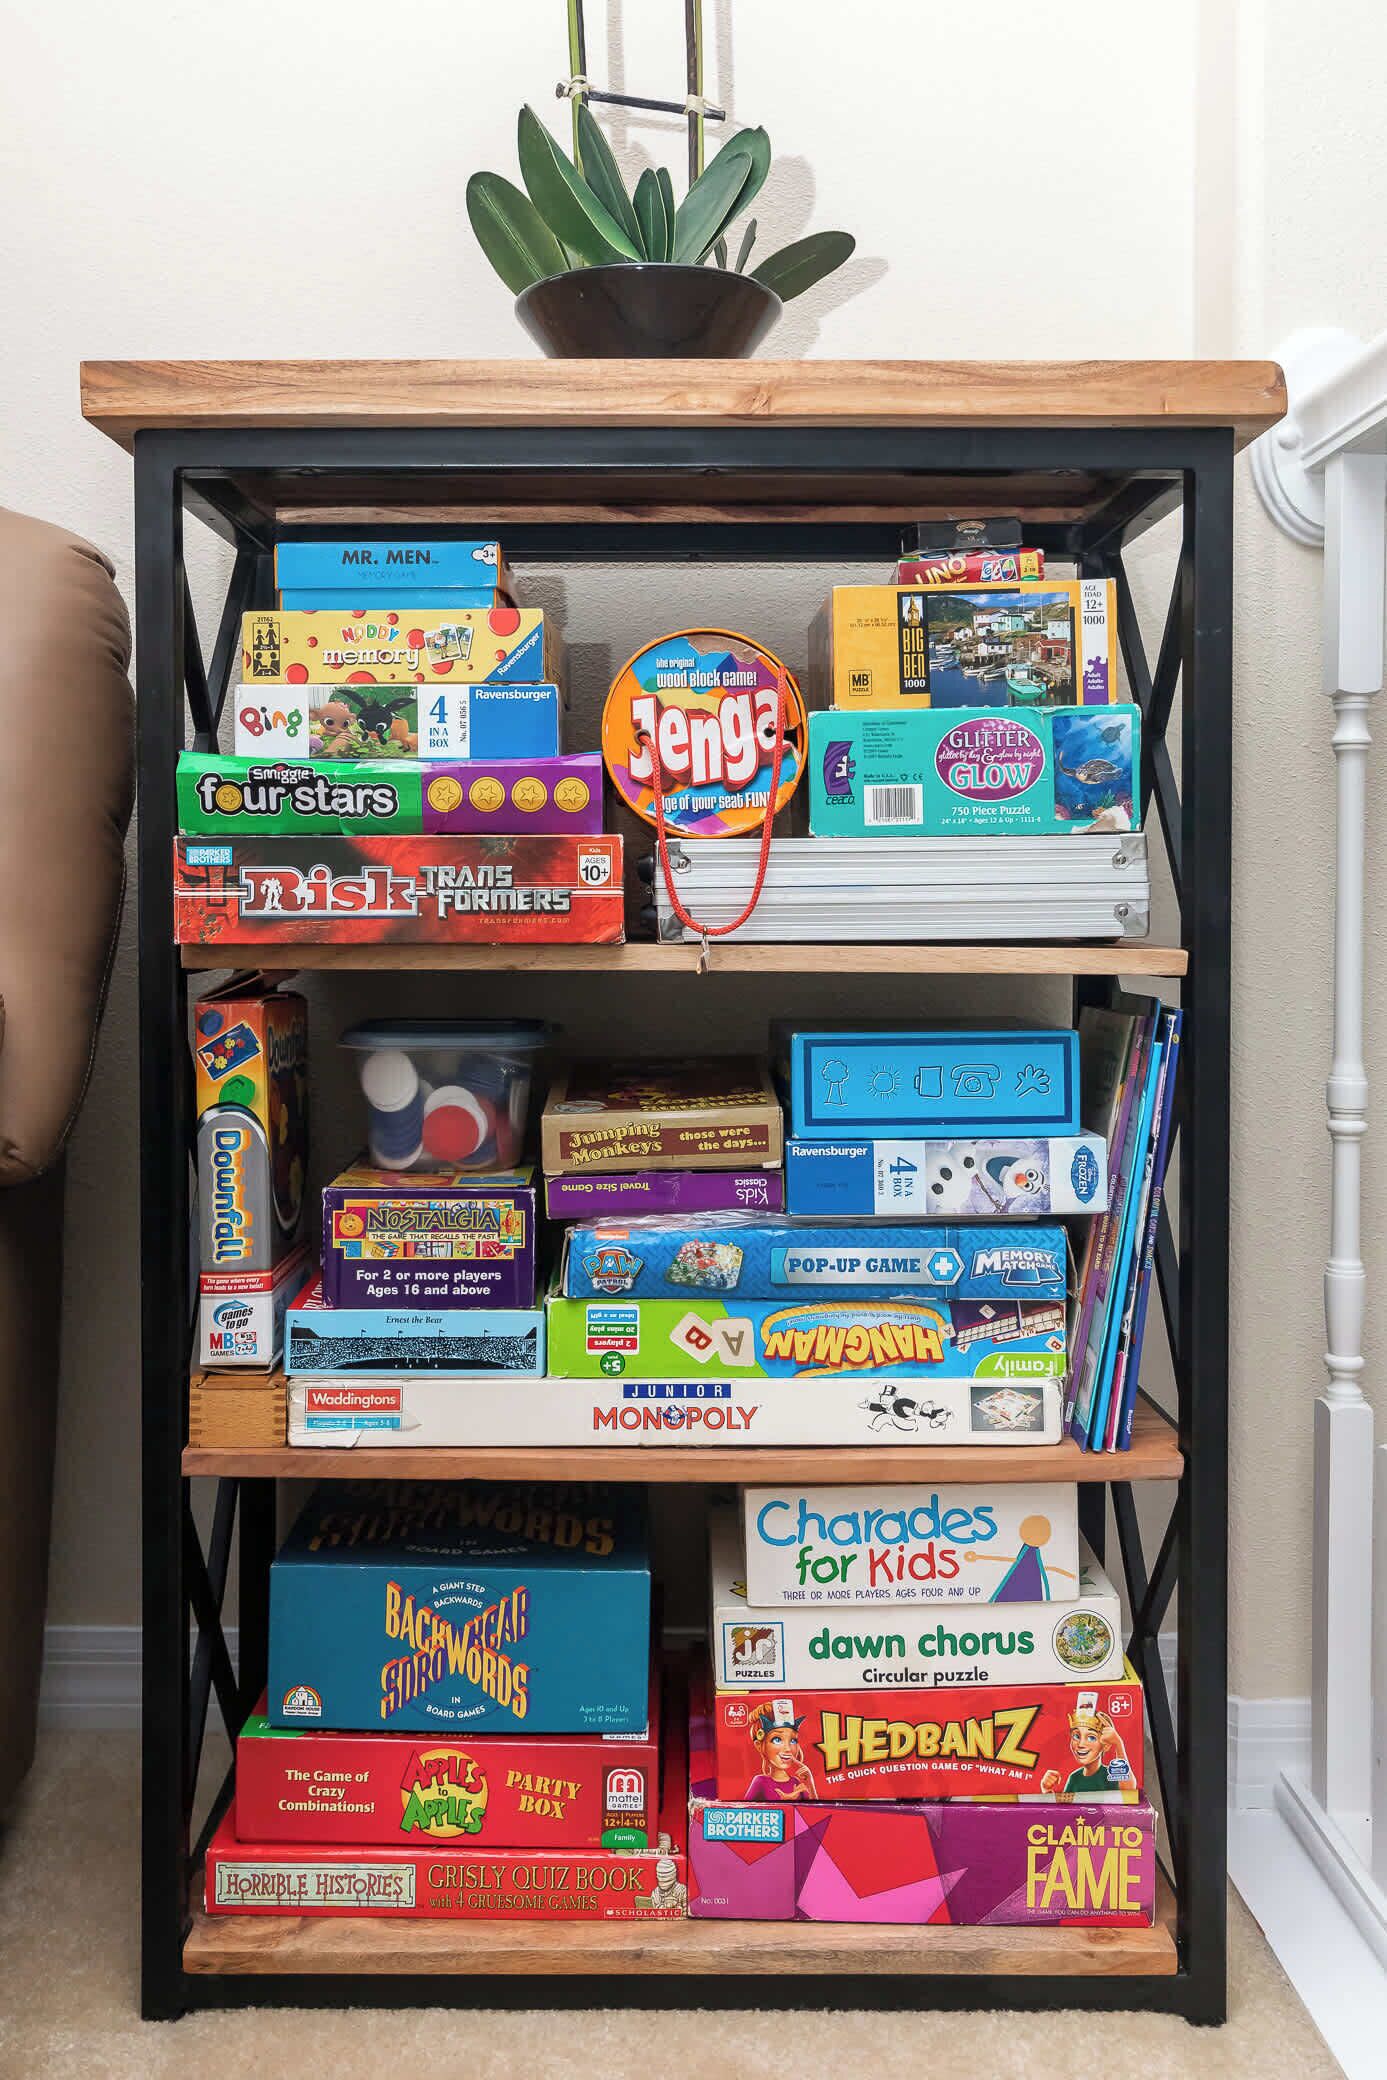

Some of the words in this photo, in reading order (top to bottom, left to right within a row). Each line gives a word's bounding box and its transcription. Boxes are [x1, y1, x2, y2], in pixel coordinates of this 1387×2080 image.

[342, 550, 378, 565] MR.
[386, 550, 430, 565] MEN
[914, 559, 967, 584] UNO
[1086, 600, 1103, 609] 12+
[1083, 615, 1105, 625] 1000
[342, 624, 399, 644] NODDY
[903, 627, 924, 653] BIG
[322, 651, 419, 671] memory
[497, 632, 540, 676] Ravensburger
[656, 658, 669, 668] the
[669, 657, 695, 669] original
[903, 653, 925, 679] BEN
[852, 674, 869, 687] MB
[904, 679, 926, 688] 1000
[475, 689, 552, 702] Ravensburger
[429, 695, 449, 724] 4
[239, 706, 303, 738] Bing
[429, 738, 449, 748] BOX
[628, 685, 780, 790] Jenga
[948, 730, 1031, 748] GLITTER
[948, 763, 1032, 789] GLOW
[199, 776, 286, 812] four
[293, 778, 394, 814] stars
[951, 806, 970, 816] 750
[972, 806, 998, 816] Piece
[999, 805, 1031, 815] Puzzle
[190, 855, 231, 864] BROTHERS
[419, 865, 513, 894] TRANS
[582, 865, 609, 881] 10+
[244, 868, 415, 912] Risk
[437, 889, 572, 919] FORMERS
[569, 1122, 662, 1148] Jumping
[679, 1129, 716, 1142] those
[718, 1127, 751, 1137] were
[698, 1141, 720, 1151] the
[723, 1136, 767, 1149] days...
[570, 1140, 663, 1167] Monkeys
[792, 1146, 868, 1159] Ravensburger
[889, 1156, 918, 1175] 4
[735, 1178, 768, 1187] Classics
[1077, 1154, 1089, 1195] FROZEN
[561, 1183, 594, 1193] Game
[595, 1182, 618, 1192] Size
[620, 1182, 651, 1192] Travel
[893, 1177, 902, 1198] BOX
[213, 1130, 243, 1262] Downfall
[736, 1187, 769, 1206] Kids
[366, 1208, 499, 1232] NOSTALGIA
[372, 1233, 386, 1241] THE
[388, 1233, 407, 1241] GAME
[409, 1233, 429, 1241] THAT
[430, 1233, 460, 1241] RECALLS
[462, 1233, 476, 1241] THE
[477, 1233, 496, 1241] PAST
[582, 1254, 644, 1279] PAW
[788, 1257, 860, 1273] POP-UP
[865, 1257, 921, 1273] GAME
[975, 1250, 1053, 1275] MEMORY
[356, 1270, 379, 1281] For
[383, 1270, 392, 1281] 2
[398, 1272, 411, 1281] or
[414, 1272, 450, 1281] more
[453, 1269, 502, 1284] players
[367, 1284, 398, 1298] Ages
[404, 1284, 420, 1295] 16
[424, 1284, 448, 1295] and
[453, 1284, 491, 1295] above
[221, 1307, 254, 1322] games
[386, 1315, 410, 1324] Ernest
[411, 1315, 424, 1324] the
[425, 1315, 444, 1324] Bear
[226, 1319, 236, 1330] to
[235, 1317, 249, 1329] go
[209, 1332, 234, 1350] MB
[594, 1339, 624, 1347] players
[763, 1323, 945, 1367] HANGMAN
[603, 1360, 621, 1372] 5+
[993, 1355, 1057, 1378] Family
[631, 1384, 723, 1398] JUNIOR
[312, 1392, 396, 1409] Waddingtons
[593, 1405, 758, 1431] MONOPOLY
[757, 1493, 998, 1547] Charades
[796, 1545, 858, 1586] for
[868, 1541, 960, 1588] Kids
[432, 1586, 439, 1594] A
[440, 1582, 465, 1591] GIANT
[465, 1582, 486, 1594] STEP
[783, 1590, 806, 1600] THREE
[810, 1590, 823, 1600] OR
[827, 1589, 851, 1600] MORE
[855, 1588, 891, 1599] PLAYERS
[895, 1588, 917, 1598] AGES
[921, 1587, 943, 1598] FOUR
[948, 1587, 964, 1597] AND
[968, 1587, 981, 1597] UP
[433, 1595, 484, 1609] BACKWARDS
[808, 1627, 906, 1660] dawn
[917, 1624, 1035, 1658] chorus
[735, 1670, 775, 1678] PUZZLES
[861, 1668, 929, 1685] Circular
[933, 1667, 989, 1686] puzzle
[426, 1704, 455, 1718] BOARD
[457, 1705, 486, 1719] GAMES
[1110, 1700, 1130, 1714] 8+
[816, 1705, 1042, 1771] HEDBANZ
[285, 1769, 310, 1782] The
[313, 1770, 353, 1782] Game
[355, 1771, 370, 1782] of
[400, 1750, 486, 1794] APPLES
[825, 1773, 846, 1785] THE
[847, 1766, 877, 1779] QUICK
[879, 1762, 929, 1774] QUESTION
[931, 1762, 958, 1771] GAME
[960, 1763, 974, 1772] OF
[975, 1764, 1006, 1777] "WHAT
[1007, 1769, 1023, 1779] AM
[308, 1785, 346, 1800] Crazy
[438, 1787, 449, 1797] to
[505, 1769, 583, 1800] PARTY
[278, 1799, 375, 1813] Combinations!
[608, 1794, 642, 1803] mattel
[400, 1790, 486, 1834] APPLES
[518, 1794, 567, 1820] BOX
[604, 1819, 621, 1827] 12+
[623, 1819, 646, 1827] 4-10
[726, 1811, 779, 1825] PARKER
[614, 1833, 636, 1842] Family
[707, 1824, 780, 1838] BROTHERS
[1027, 1824, 1105, 1847] CLAIM
[1110, 1826, 1143, 1848] TO
[226, 1873, 309, 1897] HORRIBLE
[315, 1873, 404, 1898] HISTORIES
[428, 1864, 507, 1890] GRISLY
[512, 1866, 570, 1891] QUIZ
[575, 1866, 645, 1892] BOOK
[1026, 1846, 1142, 1910] FAME
[430, 1896, 452, 1908] with
[455, 1892, 465, 1908] 4
[467, 1894, 547, 1910] GRUESOME
[548, 1895, 598, 1911] GAMES
[616, 1909, 681, 1917] SCHOLASTIC
